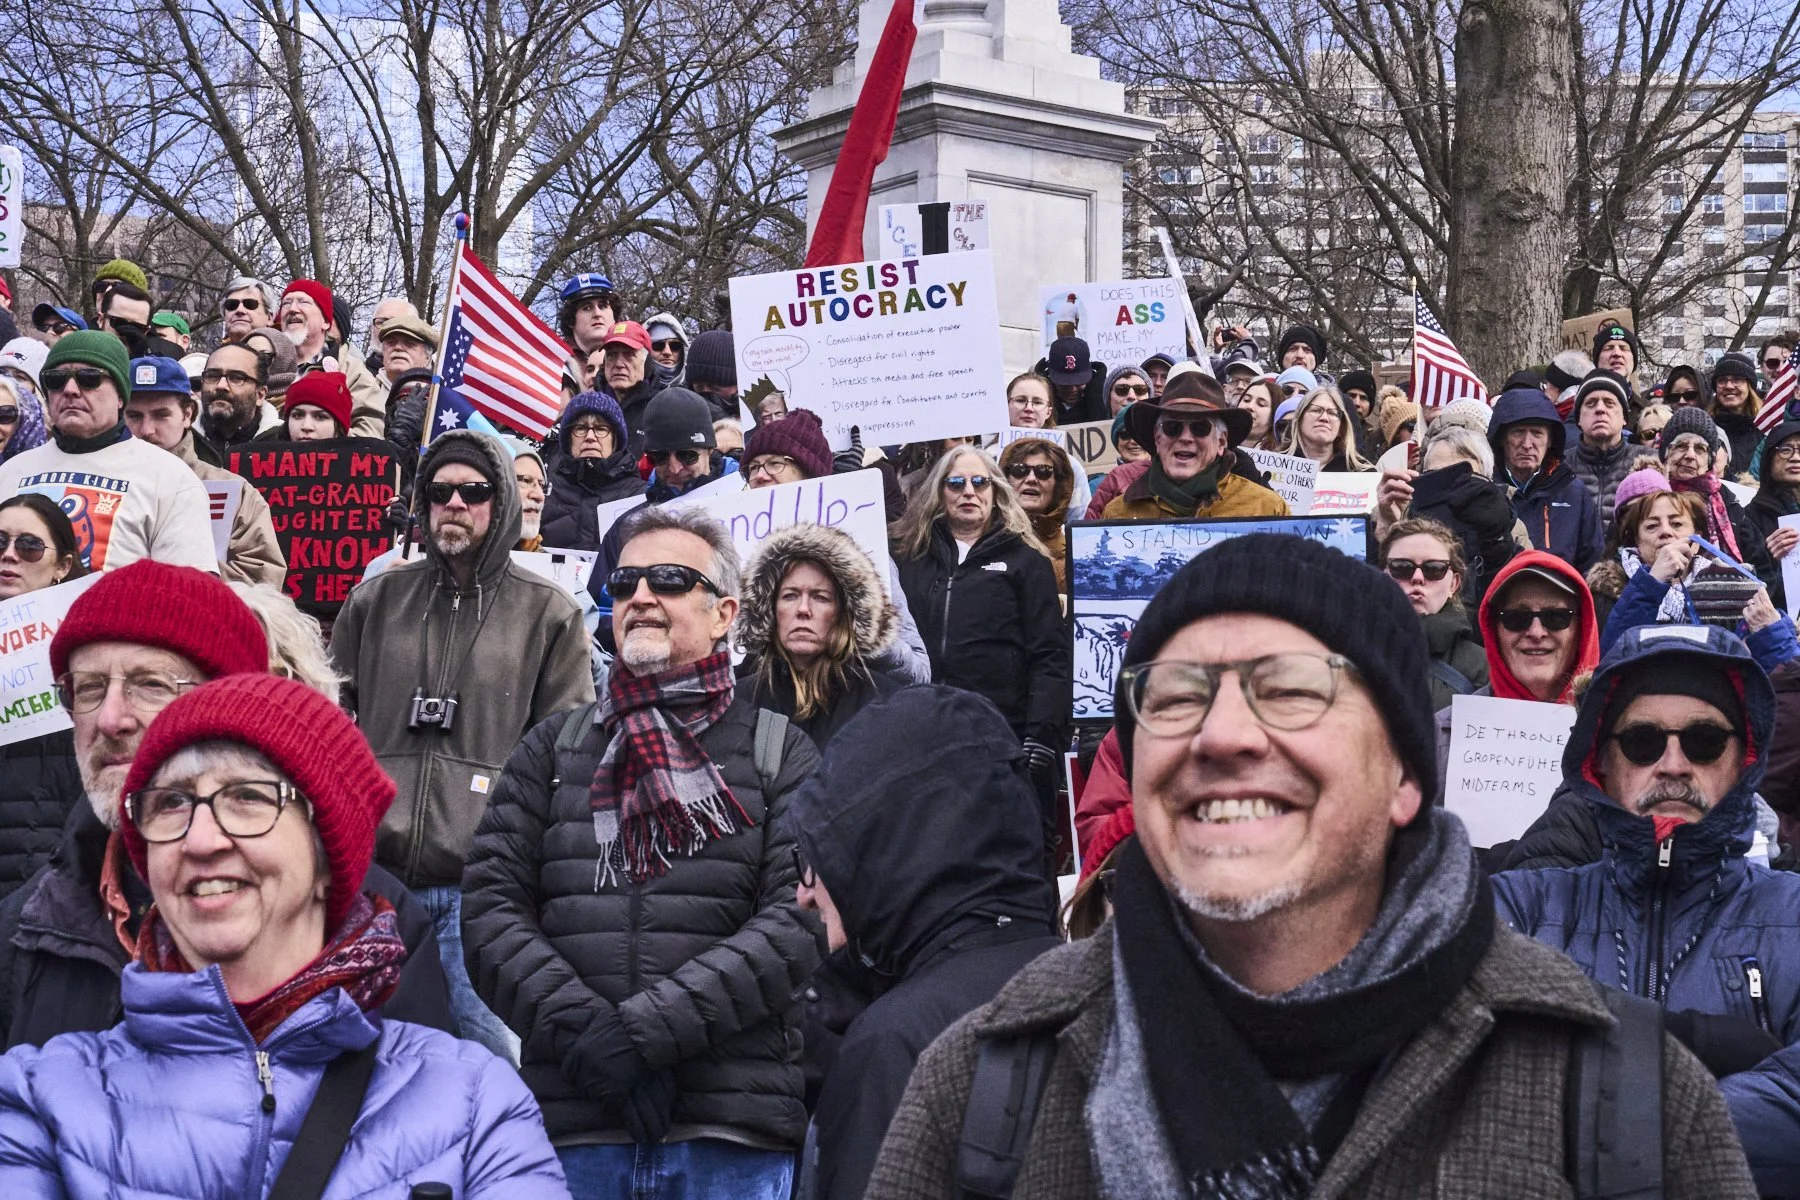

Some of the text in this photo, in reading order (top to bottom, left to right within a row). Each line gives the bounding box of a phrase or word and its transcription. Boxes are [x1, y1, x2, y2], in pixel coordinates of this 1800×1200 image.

[796, 260, 919, 298] RESIST
[1101, 284, 1174, 301] DOES THIS
[763, 281, 967, 332] AUTOCRACY
[1115, 302, 1166, 326] ASS
[826, 323, 961, 346] Consolidation of executive power
[1097, 329, 1155, 345] MAKE MY
[827, 349, 936, 368] Disregard for civil rights
[1065, 355, 1076, 369] B
[1096, 347, 1147, 360] COUNTRY
[831, 377, 868, 388] Attacks
[884, 372, 907, 382] media
[910, 372, 924, 381] and
[927, 370, 943, 379] free
[947, 367, 974, 378] speech
[832, 389, 988, 412] Disregard for Constitution and courts
[836, 418, 916, 435] Vot suppression
[1066, 427, 1107, 463] ND
[229, 451, 391, 478] I WANT MY
[1296, 461, 1314, 473] USE
[19, 472, 128, 491] NO MORE KINGS
[257, 482, 394, 508] AT-GRAND
[1276, 489, 1299, 502] OUR
[272, 508, 382, 533] UGHTER
[1122, 527, 1212, 549] STAND
[288, 536, 388, 570] KNOW
[285, 573, 362, 601] S HE
[2, 662, 38, 692] NOT
[1463, 750, 1561, 772] GROPENFUHE
[1461, 777, 1537, 797] MIDTERMS
